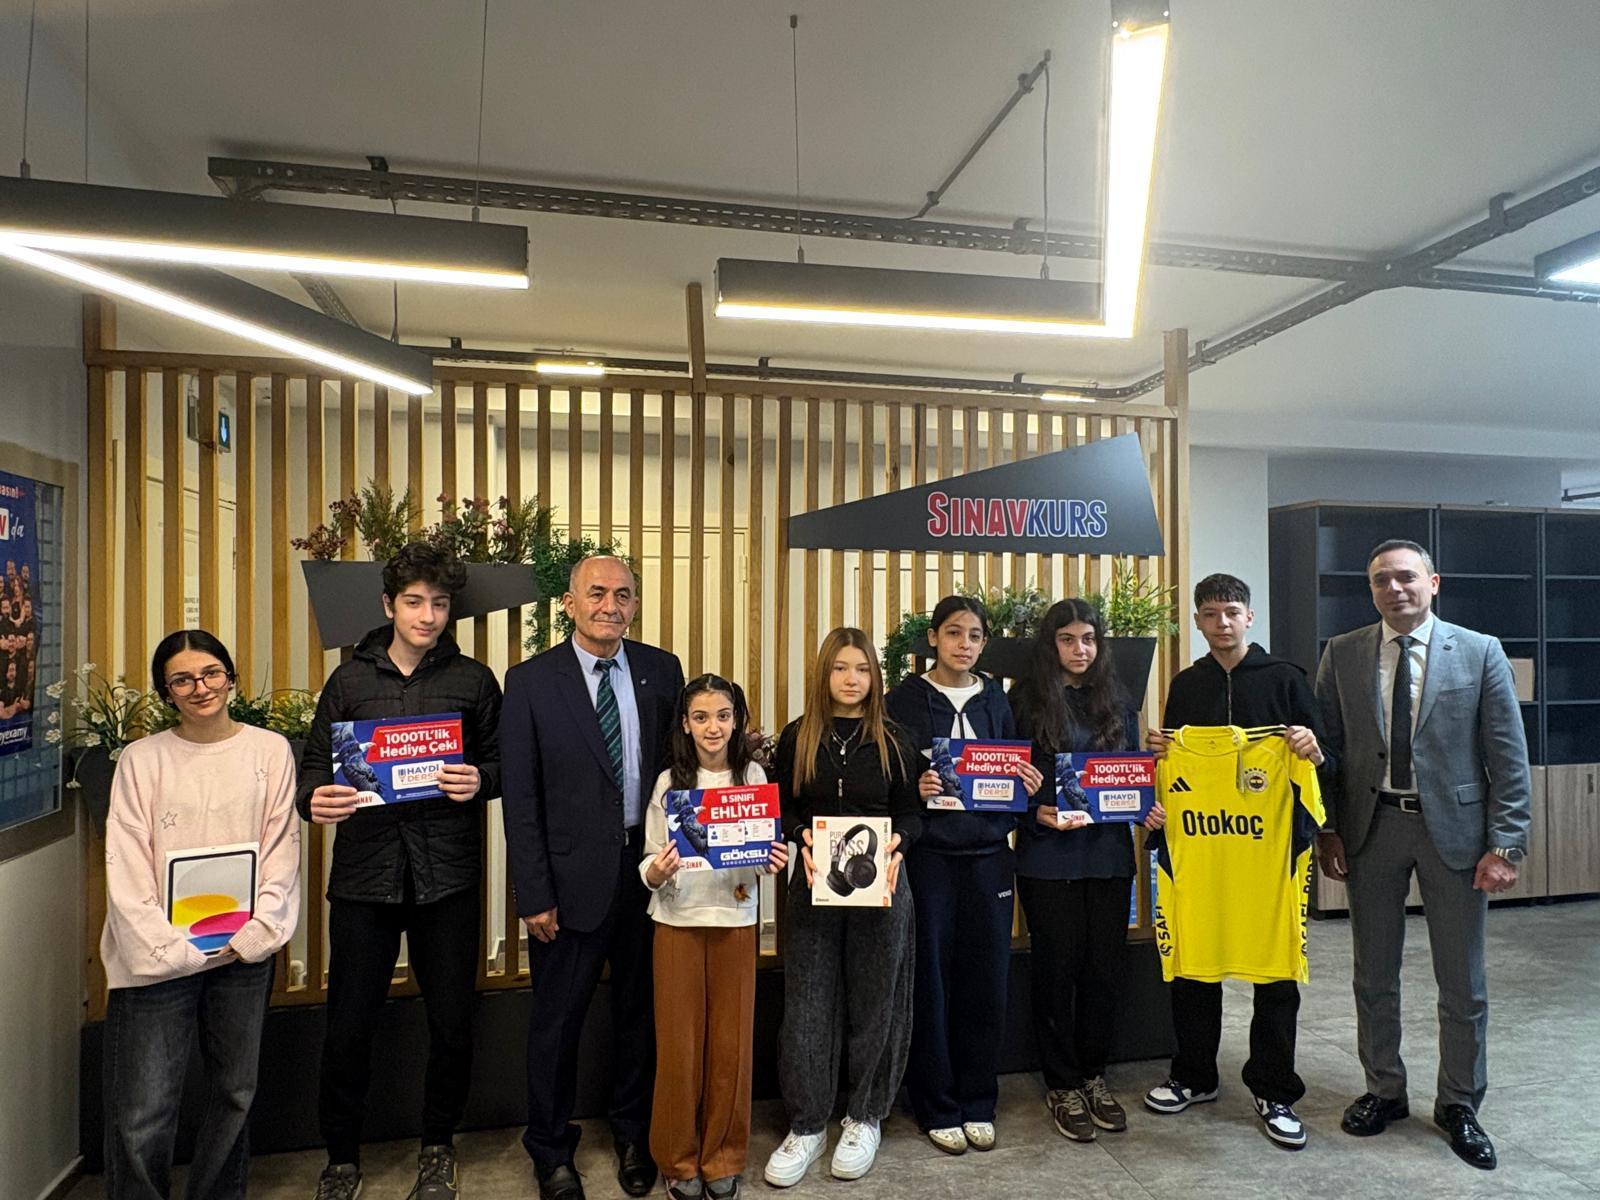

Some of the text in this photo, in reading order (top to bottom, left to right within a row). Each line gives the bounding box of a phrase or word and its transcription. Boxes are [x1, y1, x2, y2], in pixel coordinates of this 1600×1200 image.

[928, 491, 1108, 537] SINAVKURS
[384, 729, 450, 745] 1000TL'lik
[380, 739, 458, 758] Hediye Çeki
[966, 762, 1002, 774] Hediye
[1094, 764, 1145, 774] 1000TL'lik
[1090, 774, 1151, 786] Hediye Çeki
[710, 803, 768, 819] EHLİYET
[1182, 809, 1264, 840] Otokoç
[720, 849, 769, 861] GÖKSU
[829, 839, 865, 857] BASS
